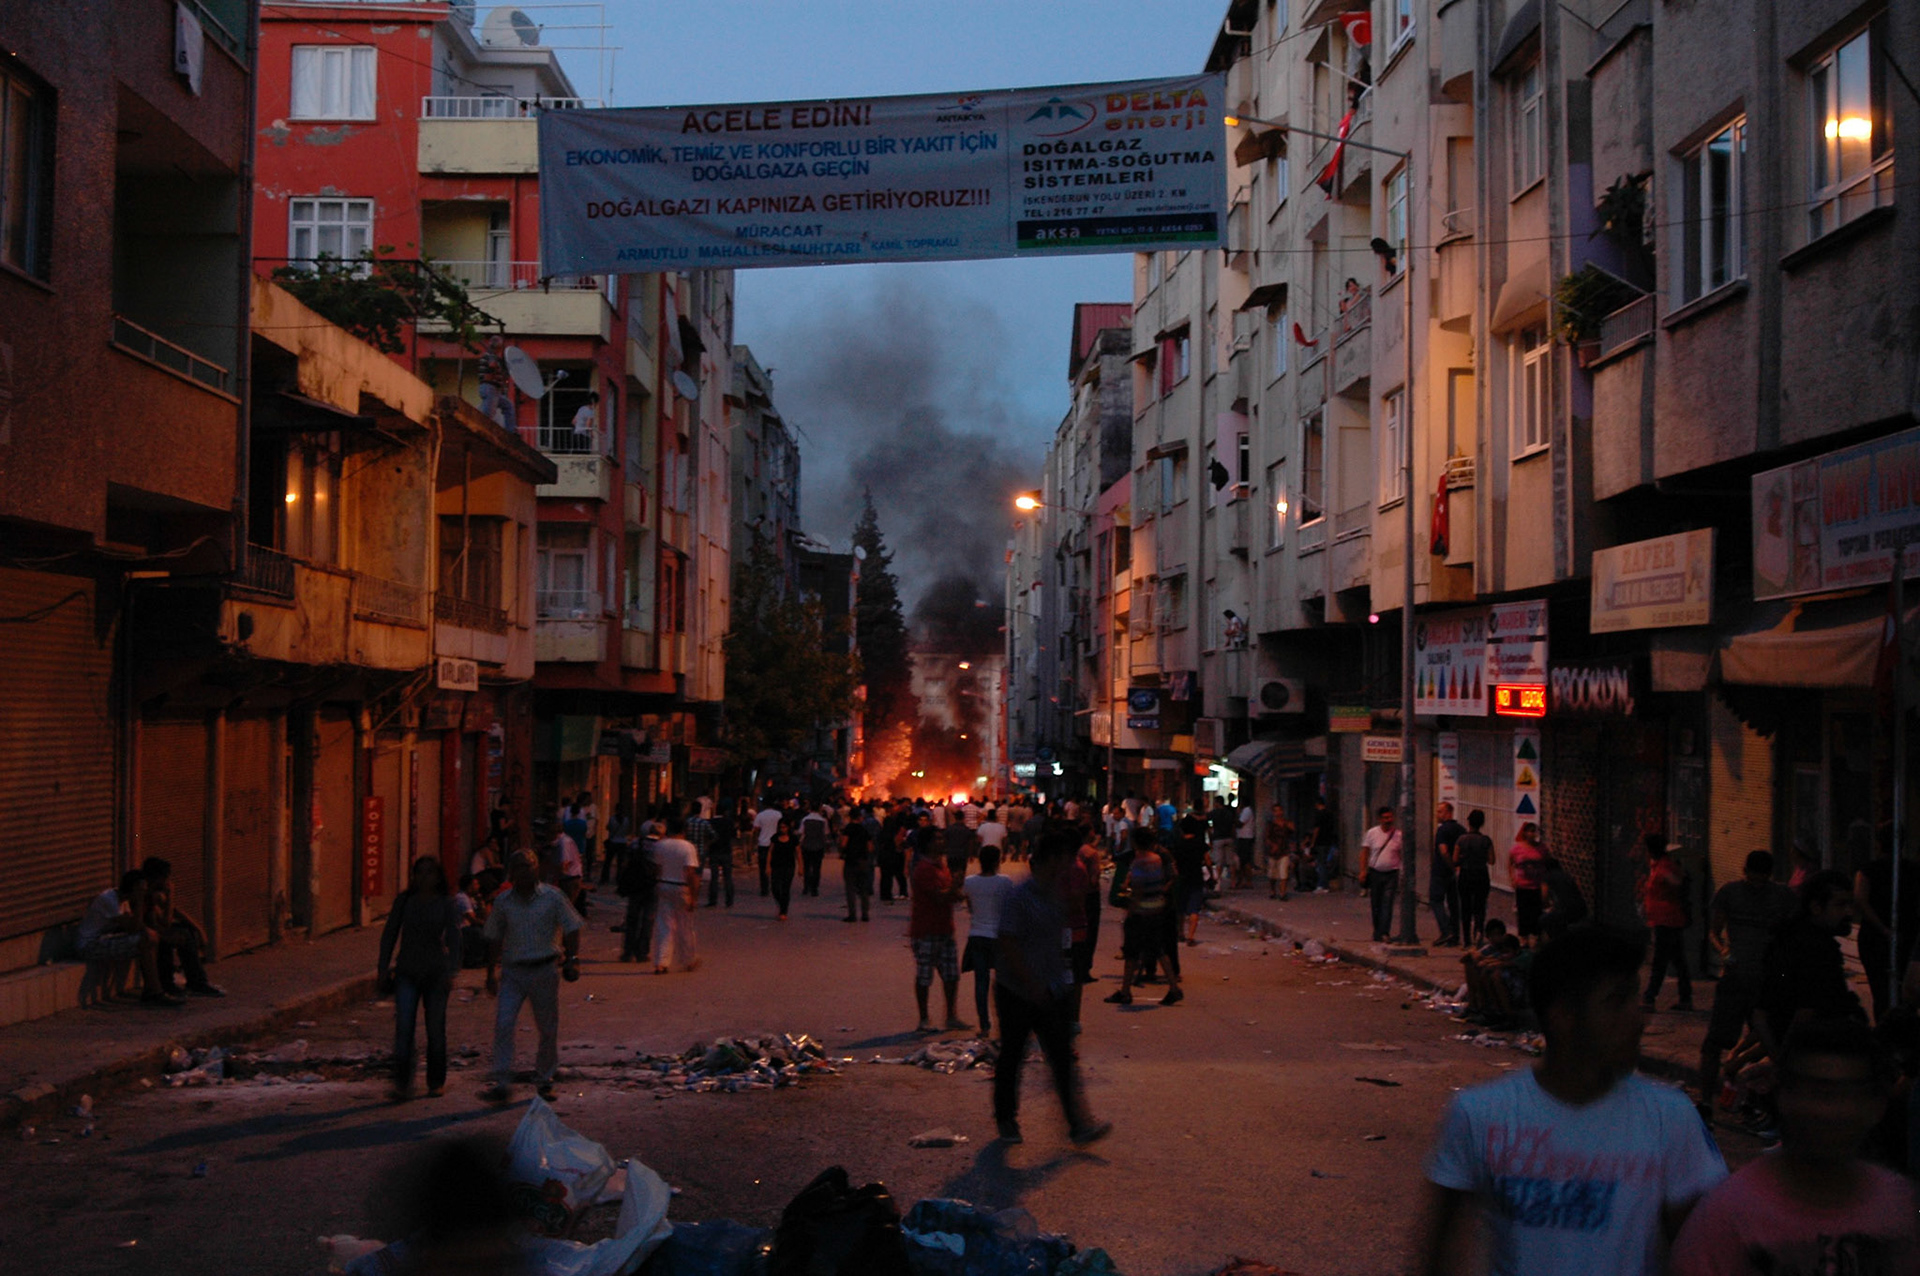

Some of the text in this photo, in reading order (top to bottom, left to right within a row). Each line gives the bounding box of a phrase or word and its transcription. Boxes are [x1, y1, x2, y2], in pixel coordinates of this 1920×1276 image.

[1106, 89, 1208, 113] DELTA
[682, 101, 872, 134] ACELE EDİN!
[936, 113, 986, 124] ANTAKYA
[1105, 110, 1206, 132] enerji
[566, 130, 998, 166] EKONOMİK, TEMİZ VE KONFORLU BİR YAKIT İÇİN
[1023, 138, 1142, 156] DOĞALGAZ
[693, 159, 869, 182] DOĞALGAZA GEÇİN
[1024, 150, 1215, 173] ISITMA-SOĞUTMA
[1025, 167, 1154, 189] SİSTEMLERİ
[587, 188, 991, 219] DOĞALGAZI KAPINIZA GETİRİYORUZ!!!
[1094, 192, 1121, 202] YOLU
[1125, 189, 1155, 201] ÜZERİ
[1171, 189, 1188, 198] KM
[1054, 206, 1073, 217] 216
[1076, 206, 1088, 216] 77
[1091, 205, 1105, 215] 47
[735, 224, 824, 239] MÜRACAAT
[1035, 226, 1081, 241] aksa
[617, 247, 688, 261] ARMUTLU
[698, 242, 785, 258] MAHALLESİ
[790, 241, 861, 255] MUHTARI
[1621, 541, 1676, 575] ZAFER
